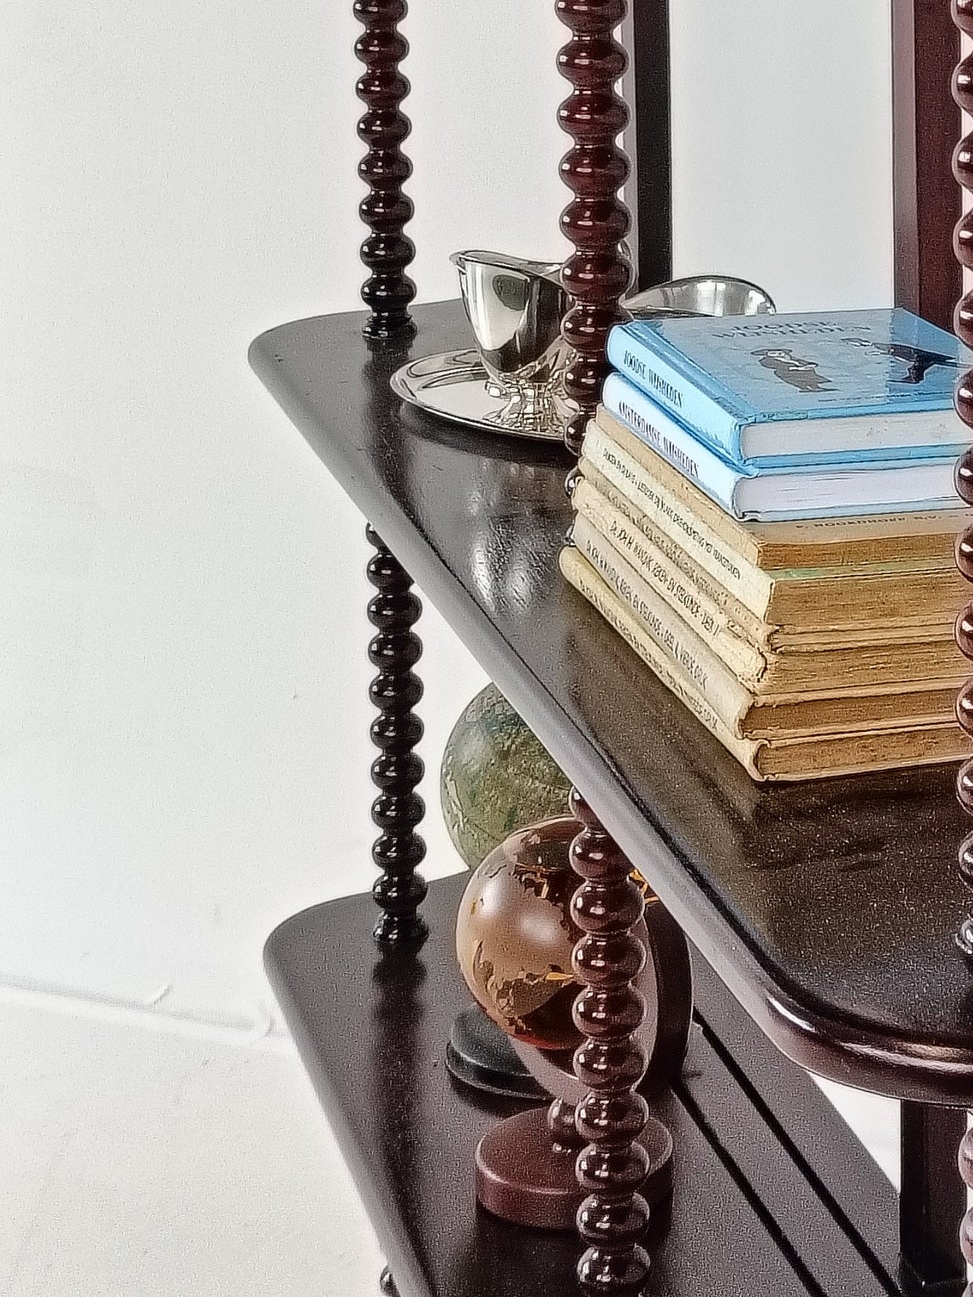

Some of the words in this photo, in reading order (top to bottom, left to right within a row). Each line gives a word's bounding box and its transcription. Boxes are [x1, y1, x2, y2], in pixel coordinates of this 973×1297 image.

[624, 350, 646, 379] JOODSE
[648, 368, 683, 408] WIJSHEDEN
[618, 400, 662, 449] AMSTERDAMSE
[663, 437, 699, 478] WIJSHEDEN
